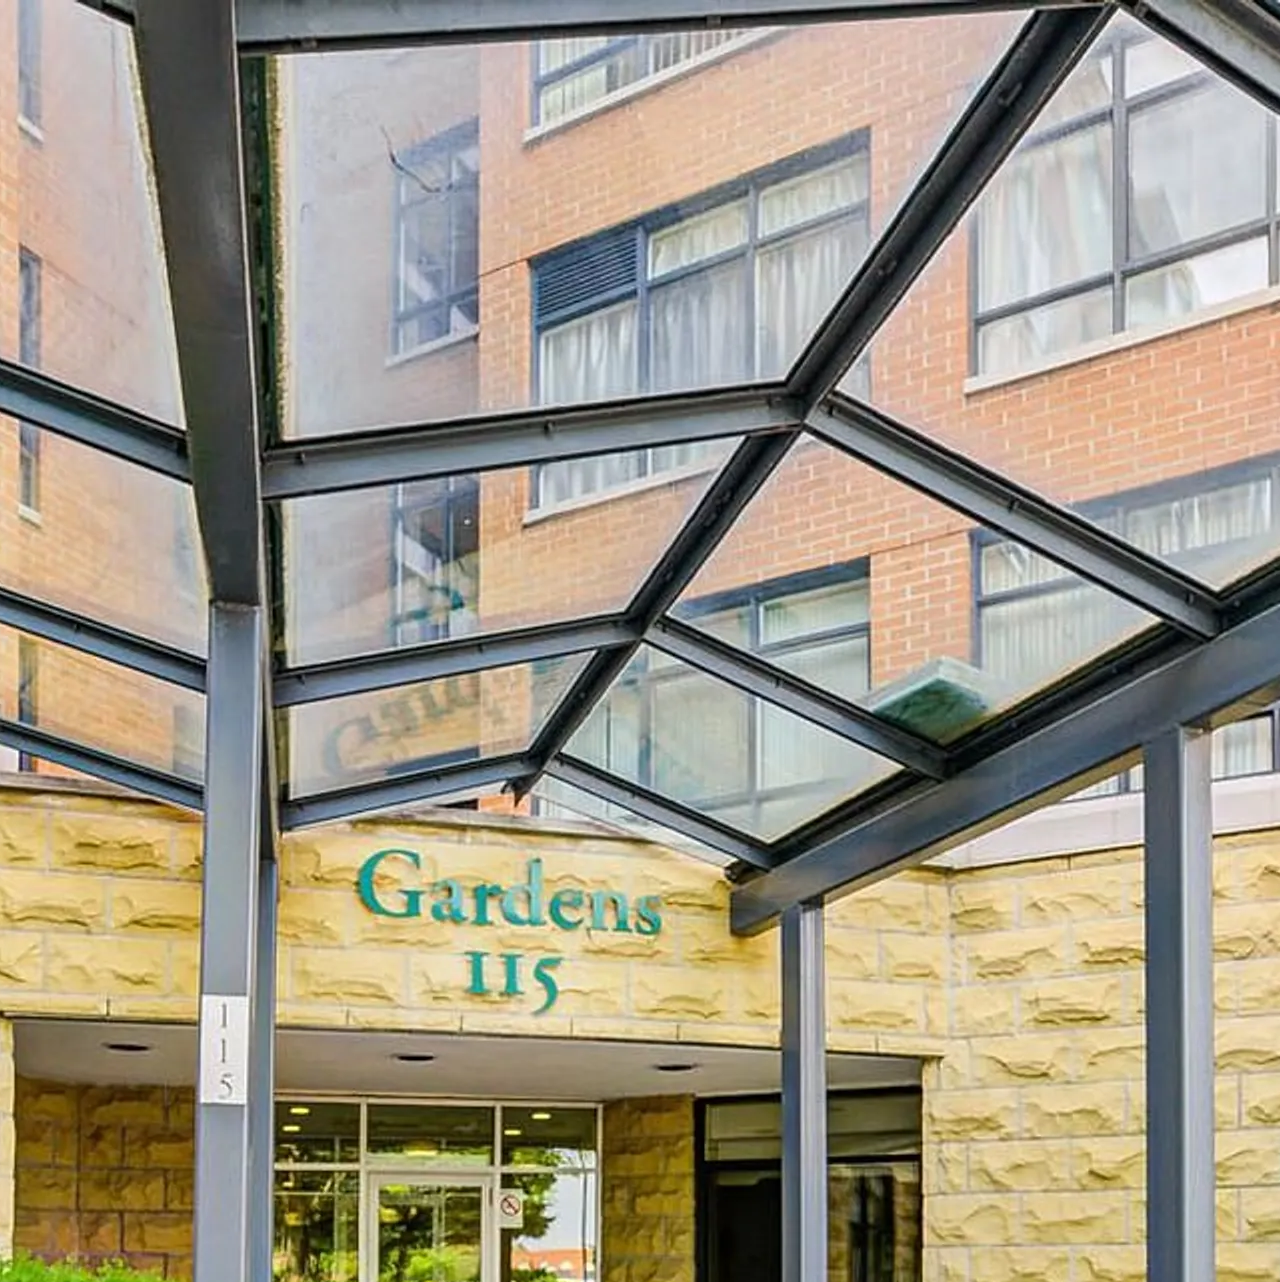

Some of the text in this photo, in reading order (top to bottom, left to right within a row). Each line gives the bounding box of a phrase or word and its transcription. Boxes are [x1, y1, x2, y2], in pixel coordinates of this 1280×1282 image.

[356, 848, 663, 935] Gardens
[464, 951, 563, 1015] 115
[218, 1003, 234, 1099] 115
